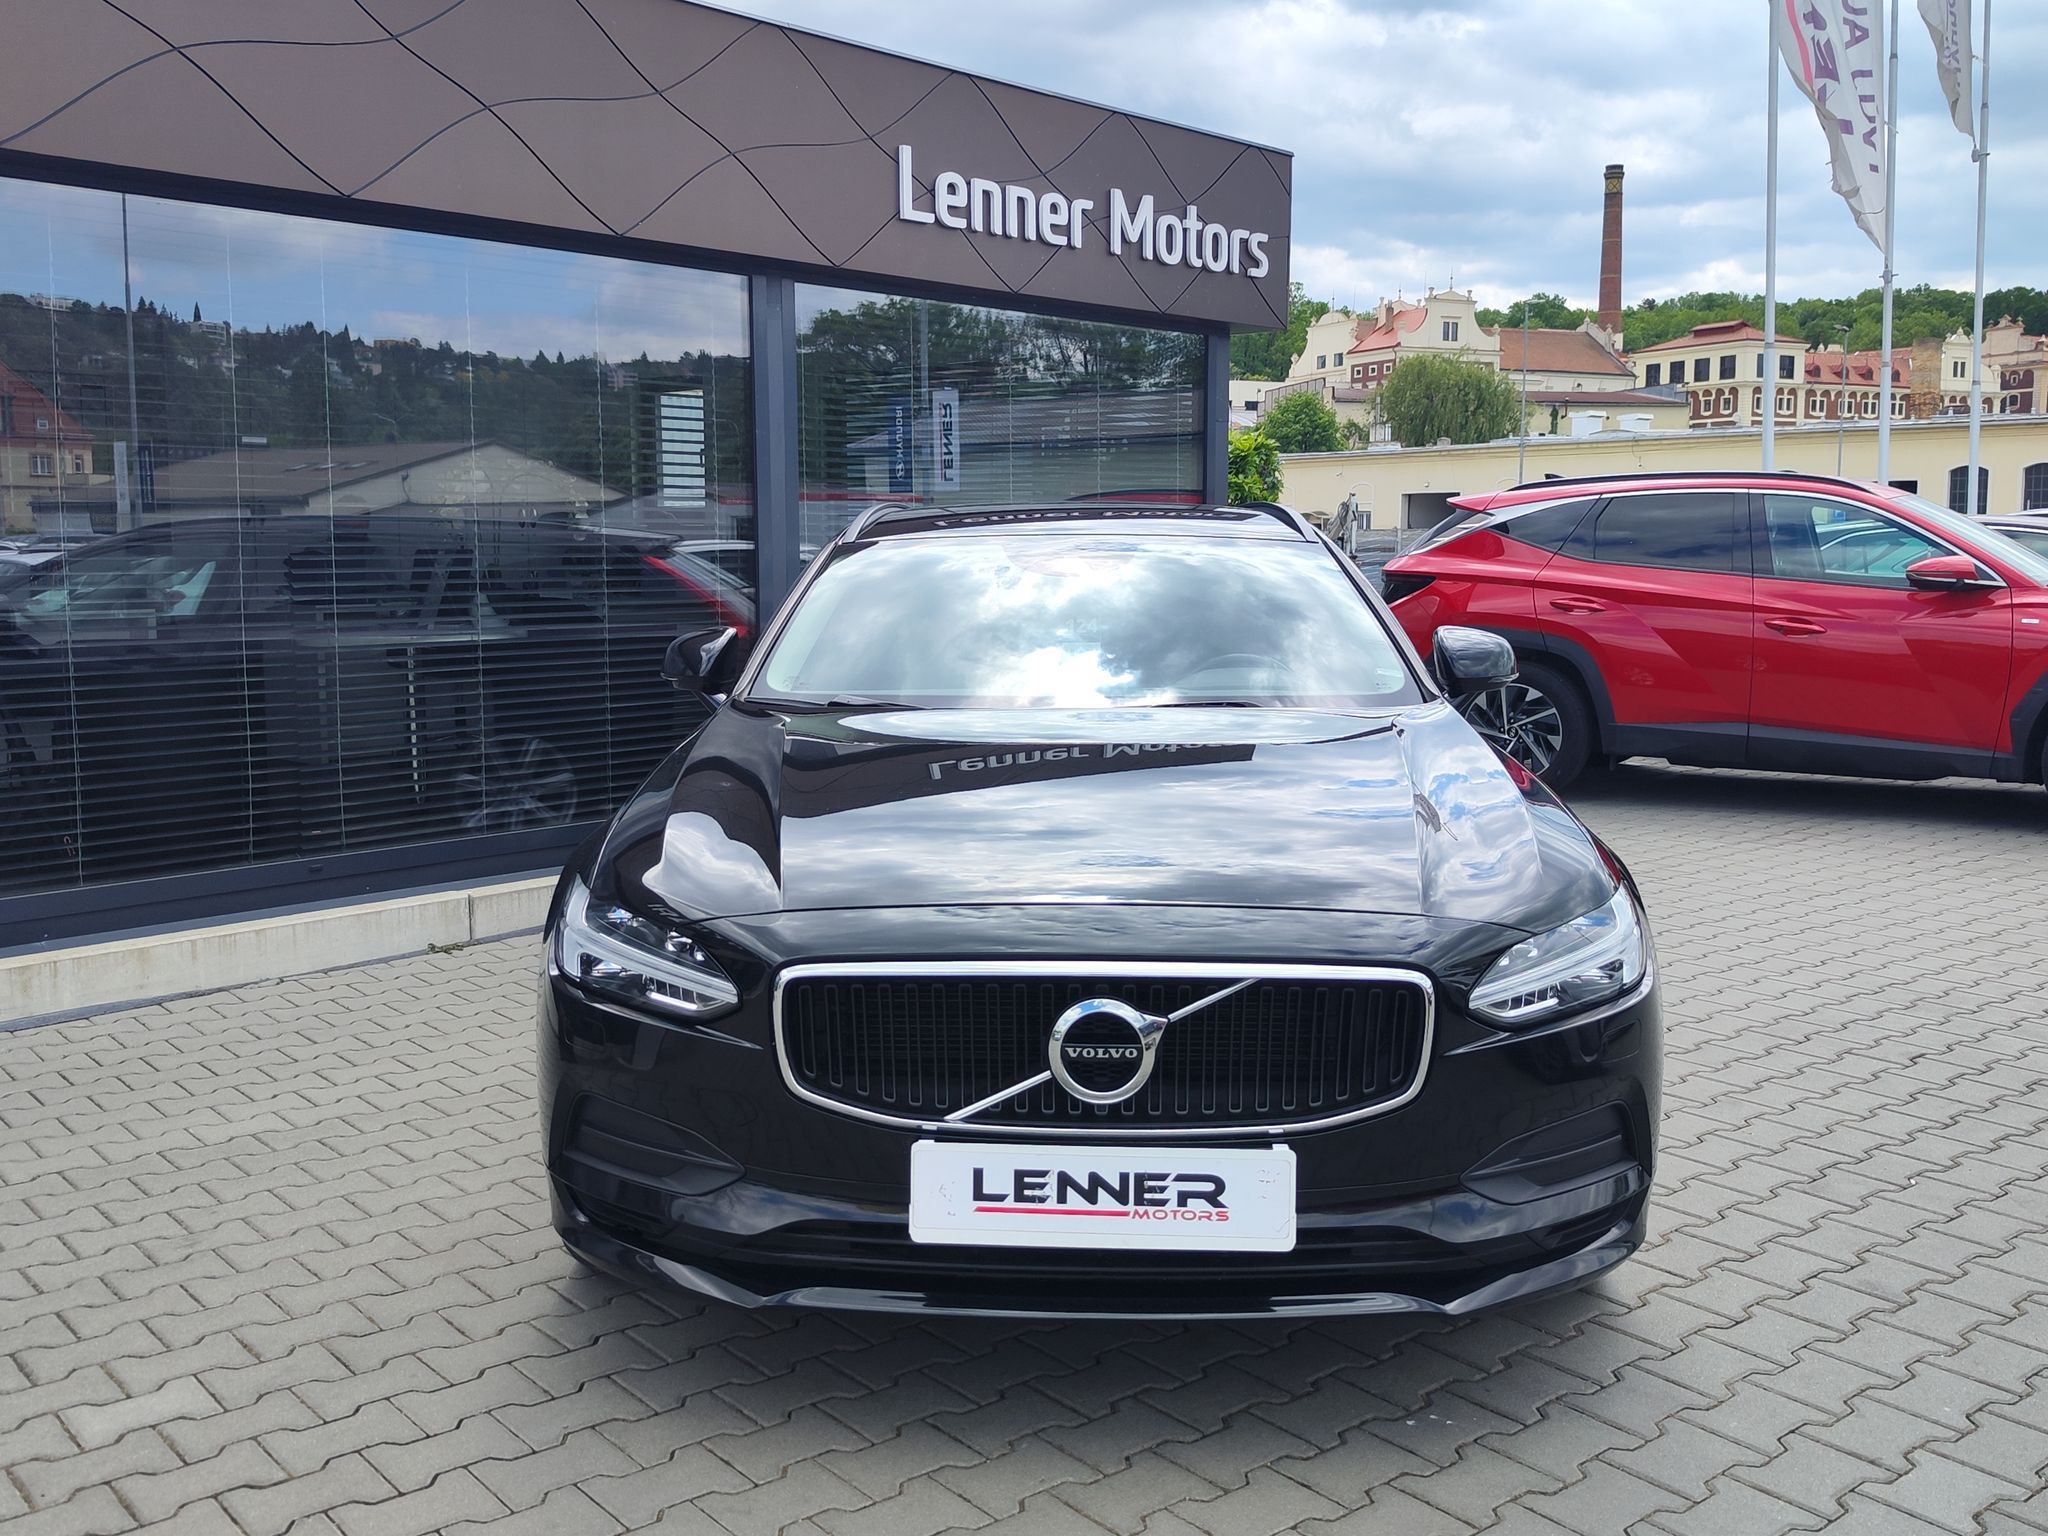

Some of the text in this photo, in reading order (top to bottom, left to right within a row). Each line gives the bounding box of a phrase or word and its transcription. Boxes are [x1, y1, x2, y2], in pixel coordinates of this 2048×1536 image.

[898, 144, 1269, 278] Lenner Motors
[1065, 1047, 1138, 1059] VOLVO
[972, 1166, 1229, 1209] LENNER
[1130, 1208, 1230, 1222] MOTORS
